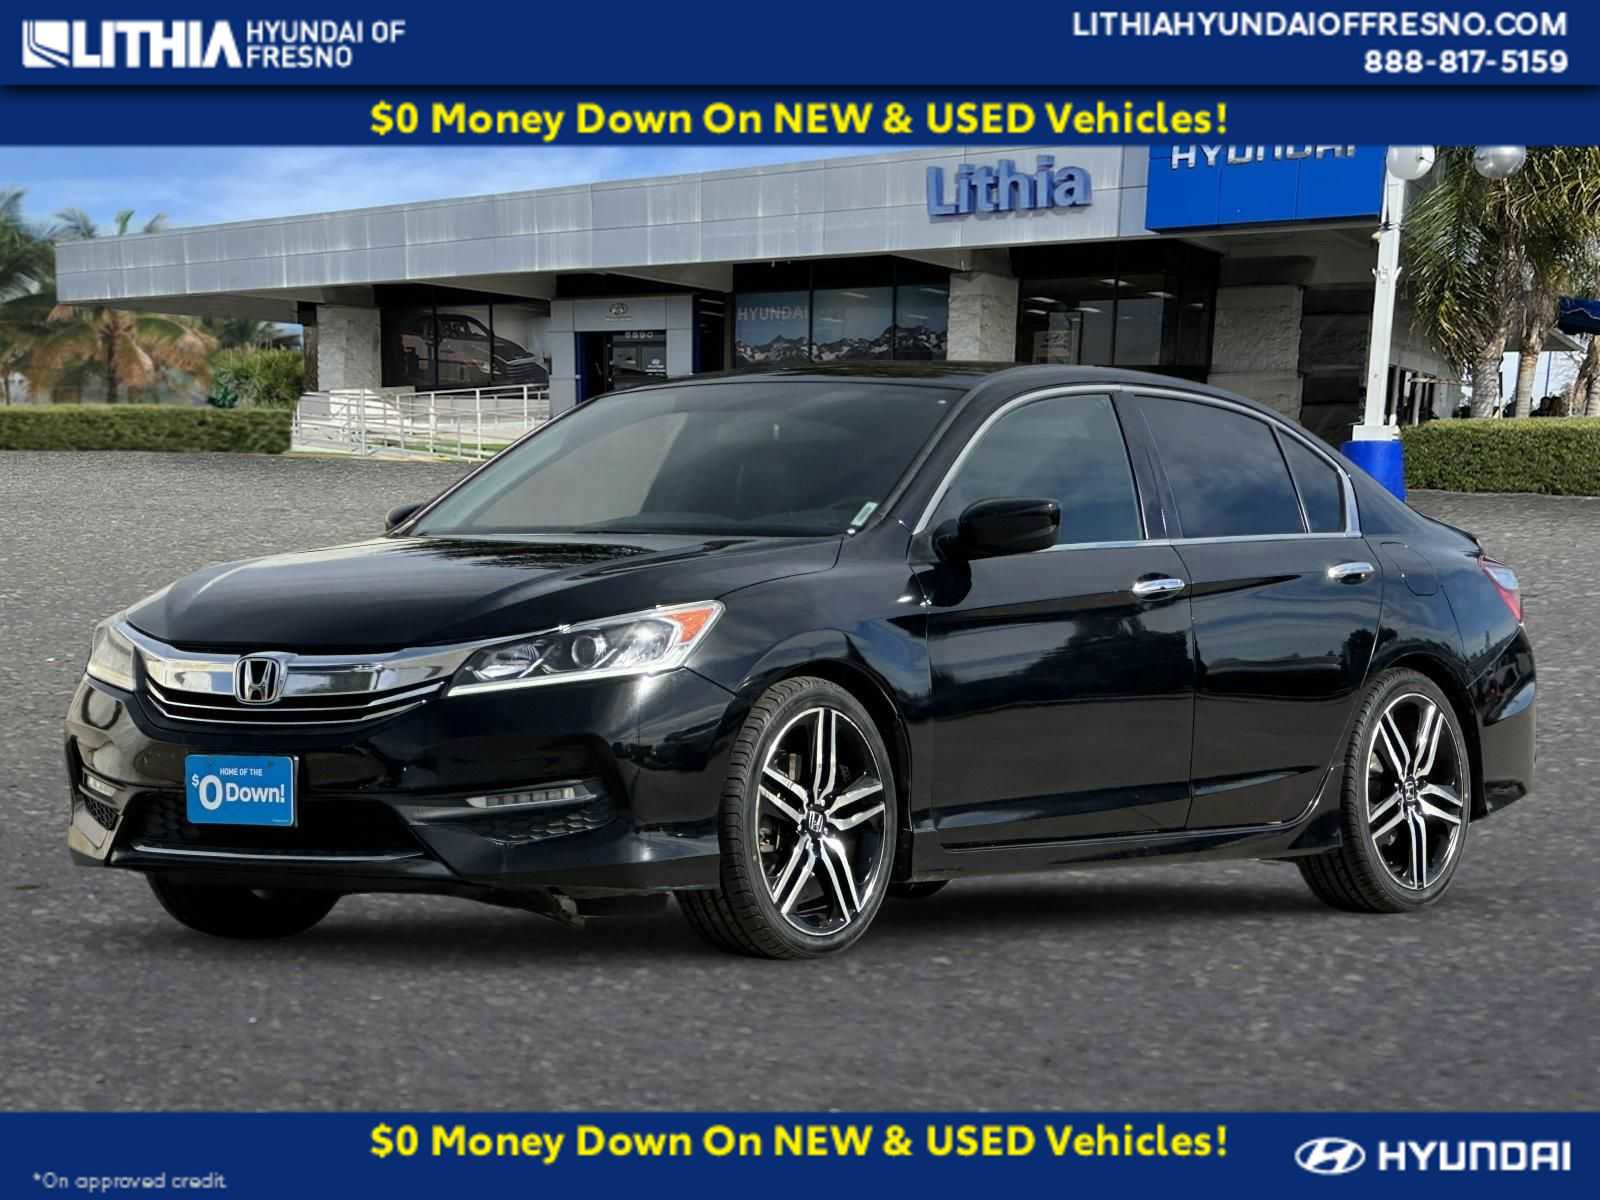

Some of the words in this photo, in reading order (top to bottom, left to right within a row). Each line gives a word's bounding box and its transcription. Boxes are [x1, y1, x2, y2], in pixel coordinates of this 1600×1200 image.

[927, 155, 1091, 215] Lithia
[736, 306, 808, 321] HYUNDAI
[219, 767, 238, 776] HOME
[239, 767, 249, 776] OF
[250, 768, 264, 777] THE
[191, 773, 223, 811] $0
[225, 782, 285, 803] Down!
